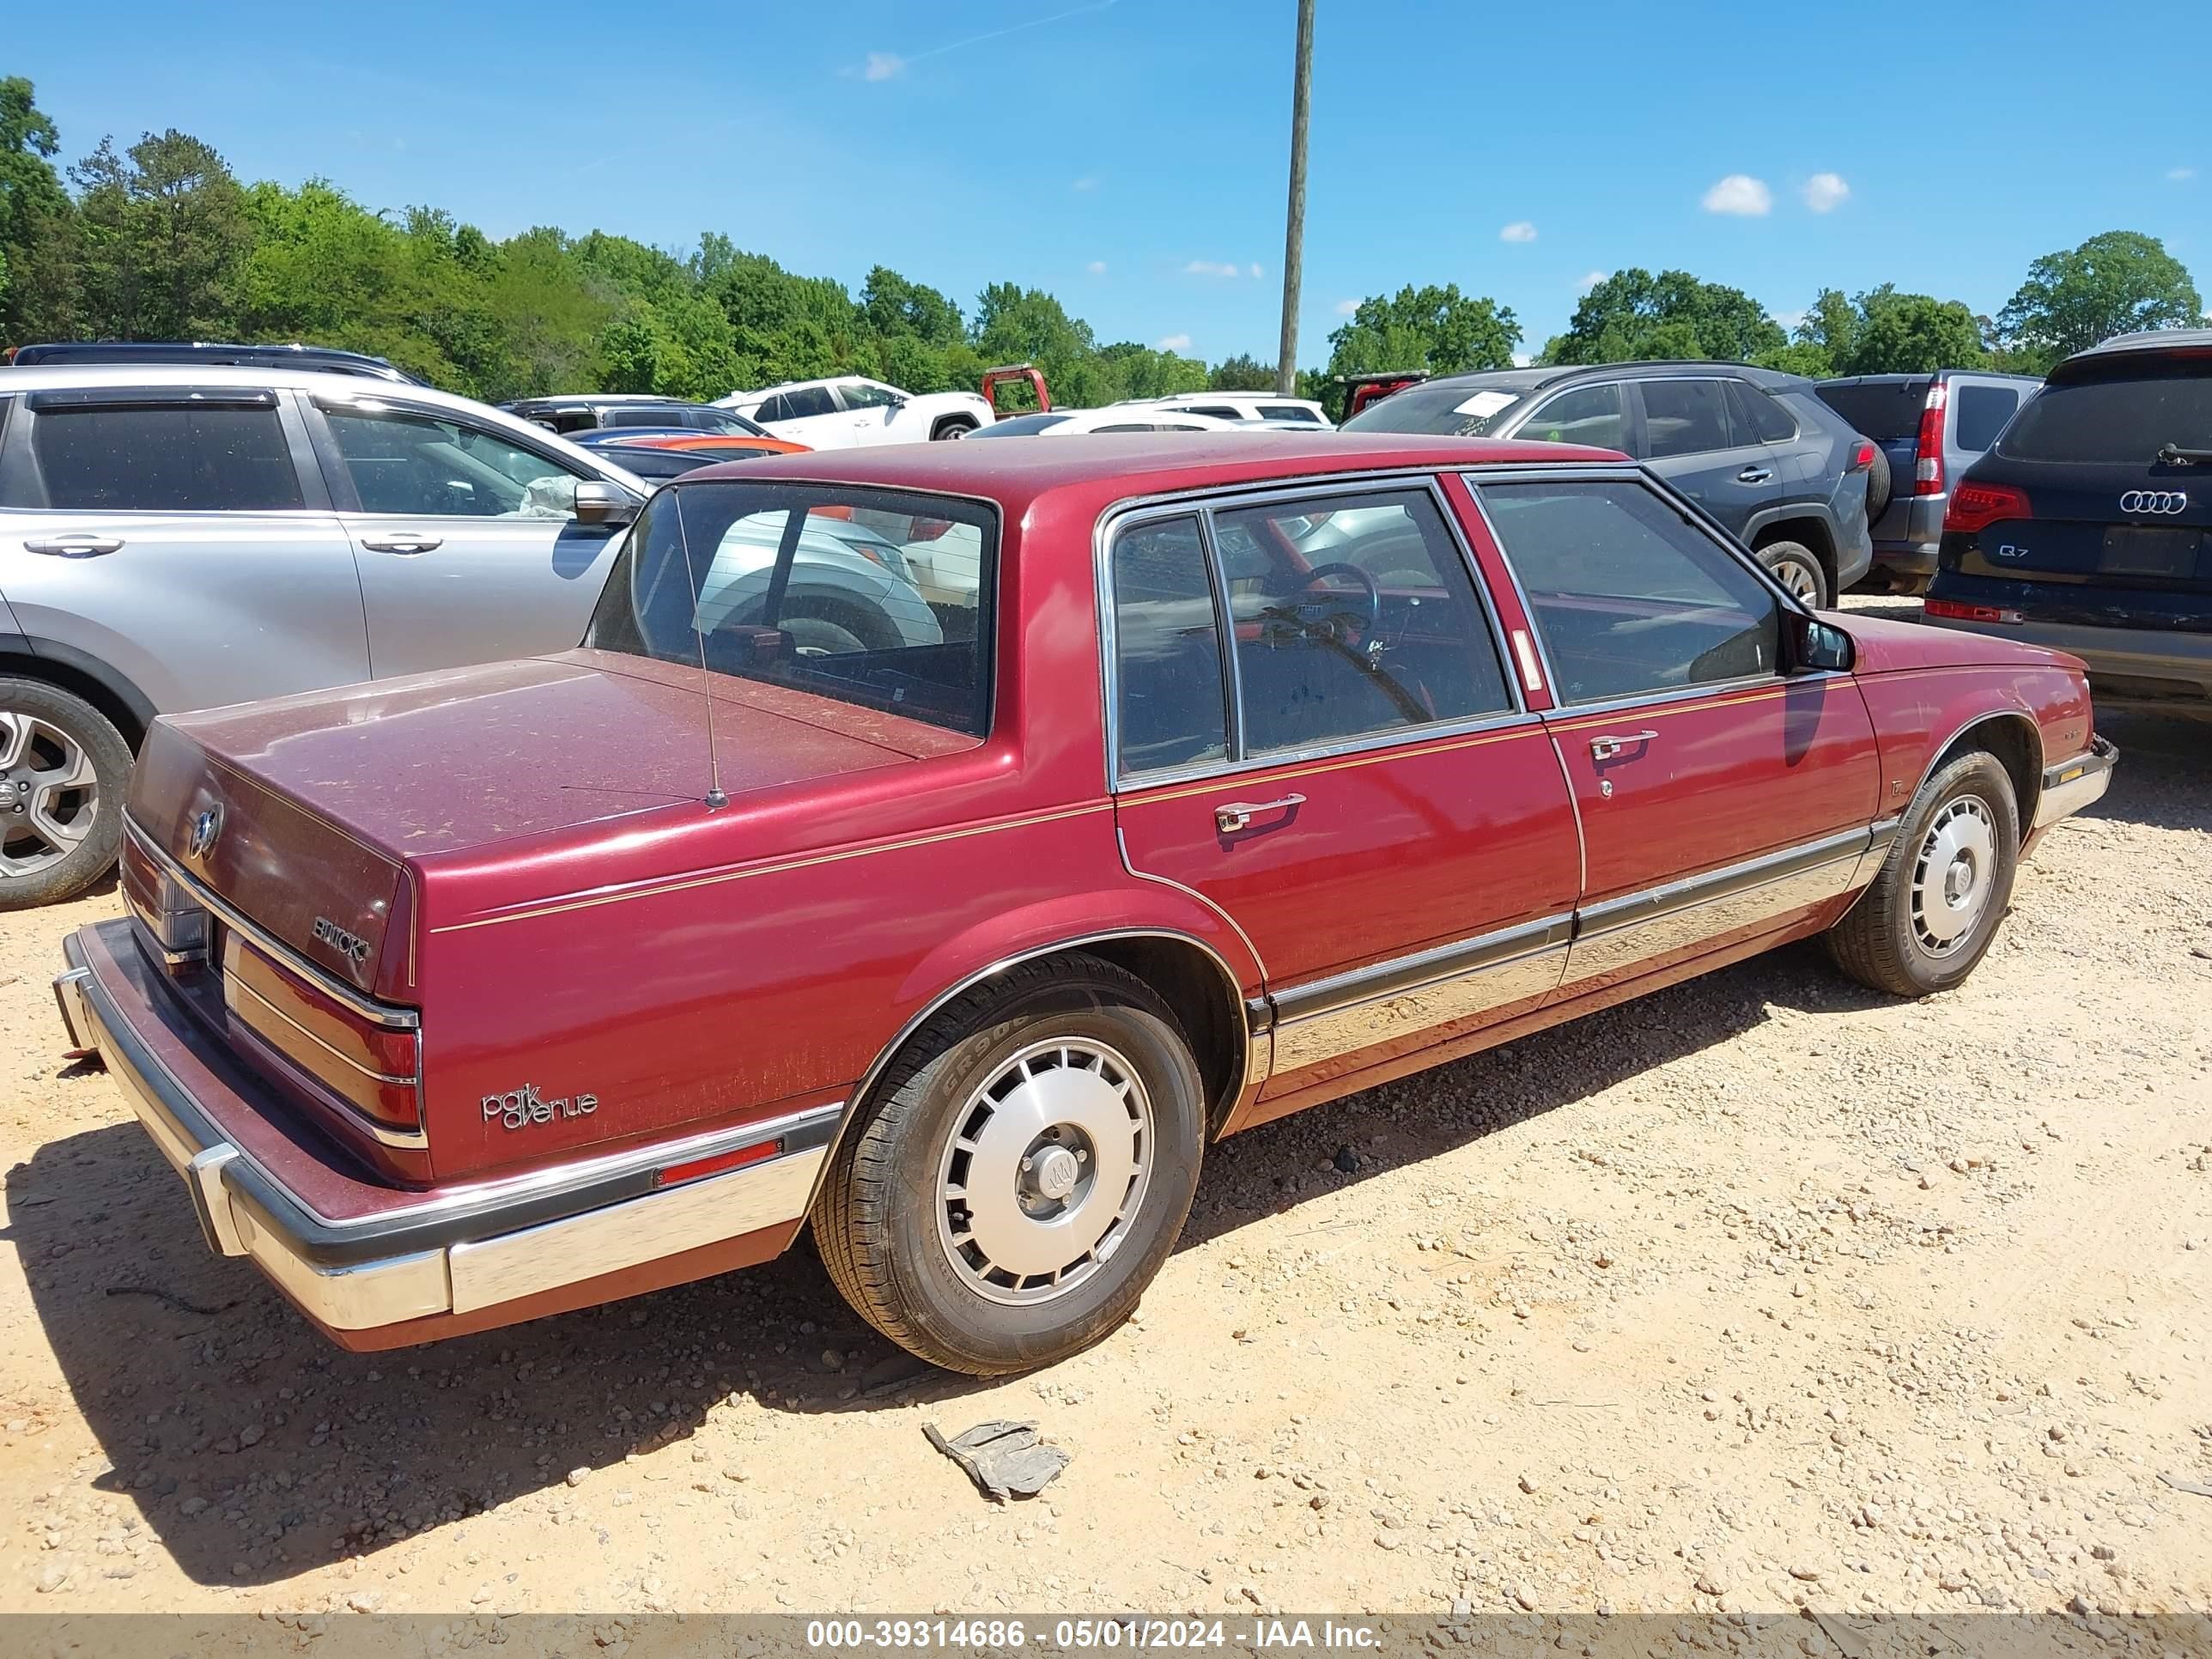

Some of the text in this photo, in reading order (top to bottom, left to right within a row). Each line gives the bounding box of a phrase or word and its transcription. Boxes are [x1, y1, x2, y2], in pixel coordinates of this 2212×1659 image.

[1999, 544, 2029, 557] Q7
[311, 915, 370, 963] BUICK
[481, 1082, 599, 1130] park avenue
